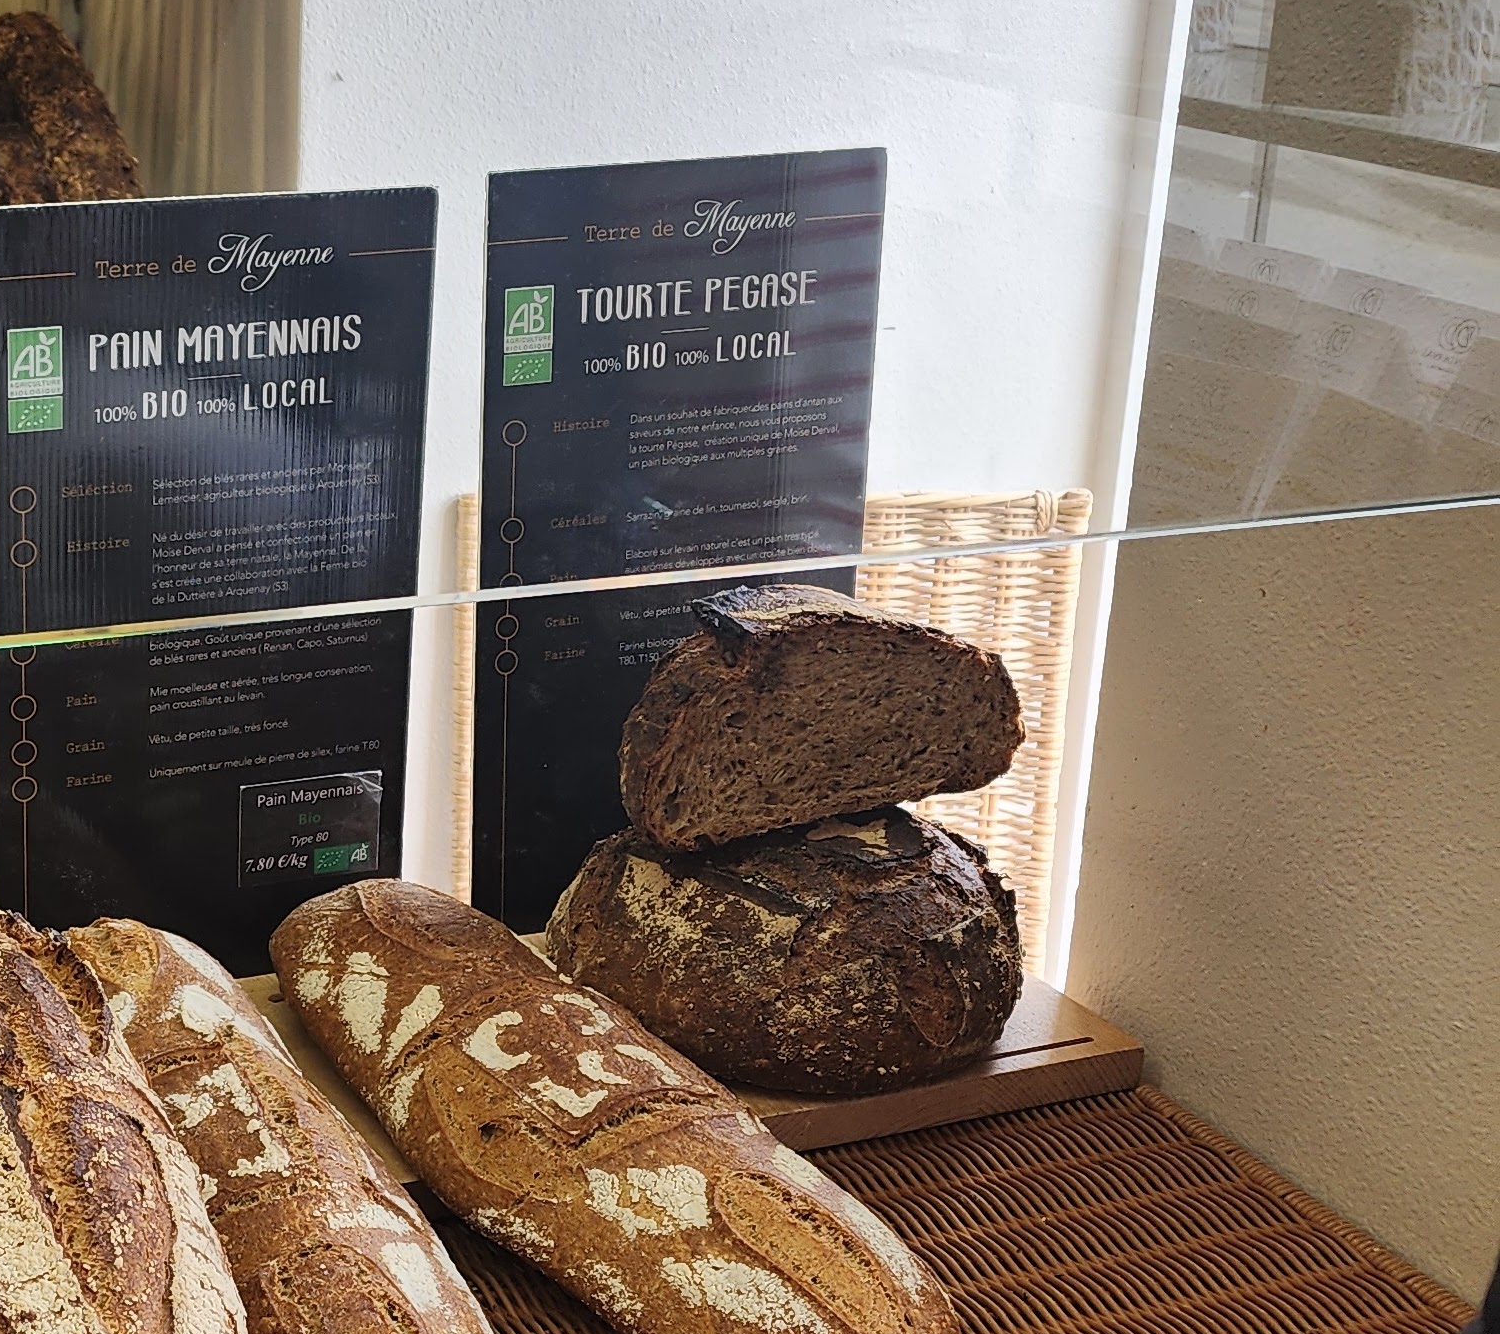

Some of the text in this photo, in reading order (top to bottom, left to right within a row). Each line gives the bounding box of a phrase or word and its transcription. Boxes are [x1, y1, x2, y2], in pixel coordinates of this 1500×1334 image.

[584, 199, 796, 255] Terre de Mayenne
[94, 233, 335, 292] Terre de Mayenne
[576, 269, 818, 325] TOURTE PEGASE
[508, 302, 545, 335] AB
[89, 314, 363, 372] PAIN MAYENNAIS
[12, 344, 54, 379] AB
[583, 330, 797, 375] 100% BIO 100% LOCAL
[94, 376, 334, 424] 100% BIO 100% LOCAL
[553, 417, 610, 433] Histoire
[551, 513, 607, 530] Céréales
[67, 537, 131, 554] Histoire
[544, 614, 581, 629] Grain
[544, 647, 586, 662] Farine
[149, 682, 218, 698] Mie moelleuse
[65, 693, 98, 708] Pain
[174, 731, 187, 742] de
[188, 728, 217, 742] petite
[244, 722, 261, 733] très
[263, 718, 289, 731] foncé
[66, 739, 105, 755] Grain
[66, 772, 113, 788] Farine
[257, 784, 364, 808] Pain Mayennais
[299, 811, 321, 825] Bio
[290, 831, 329, 848] Type 80
[245, 853, 309, 873] 7.80 €/kg
